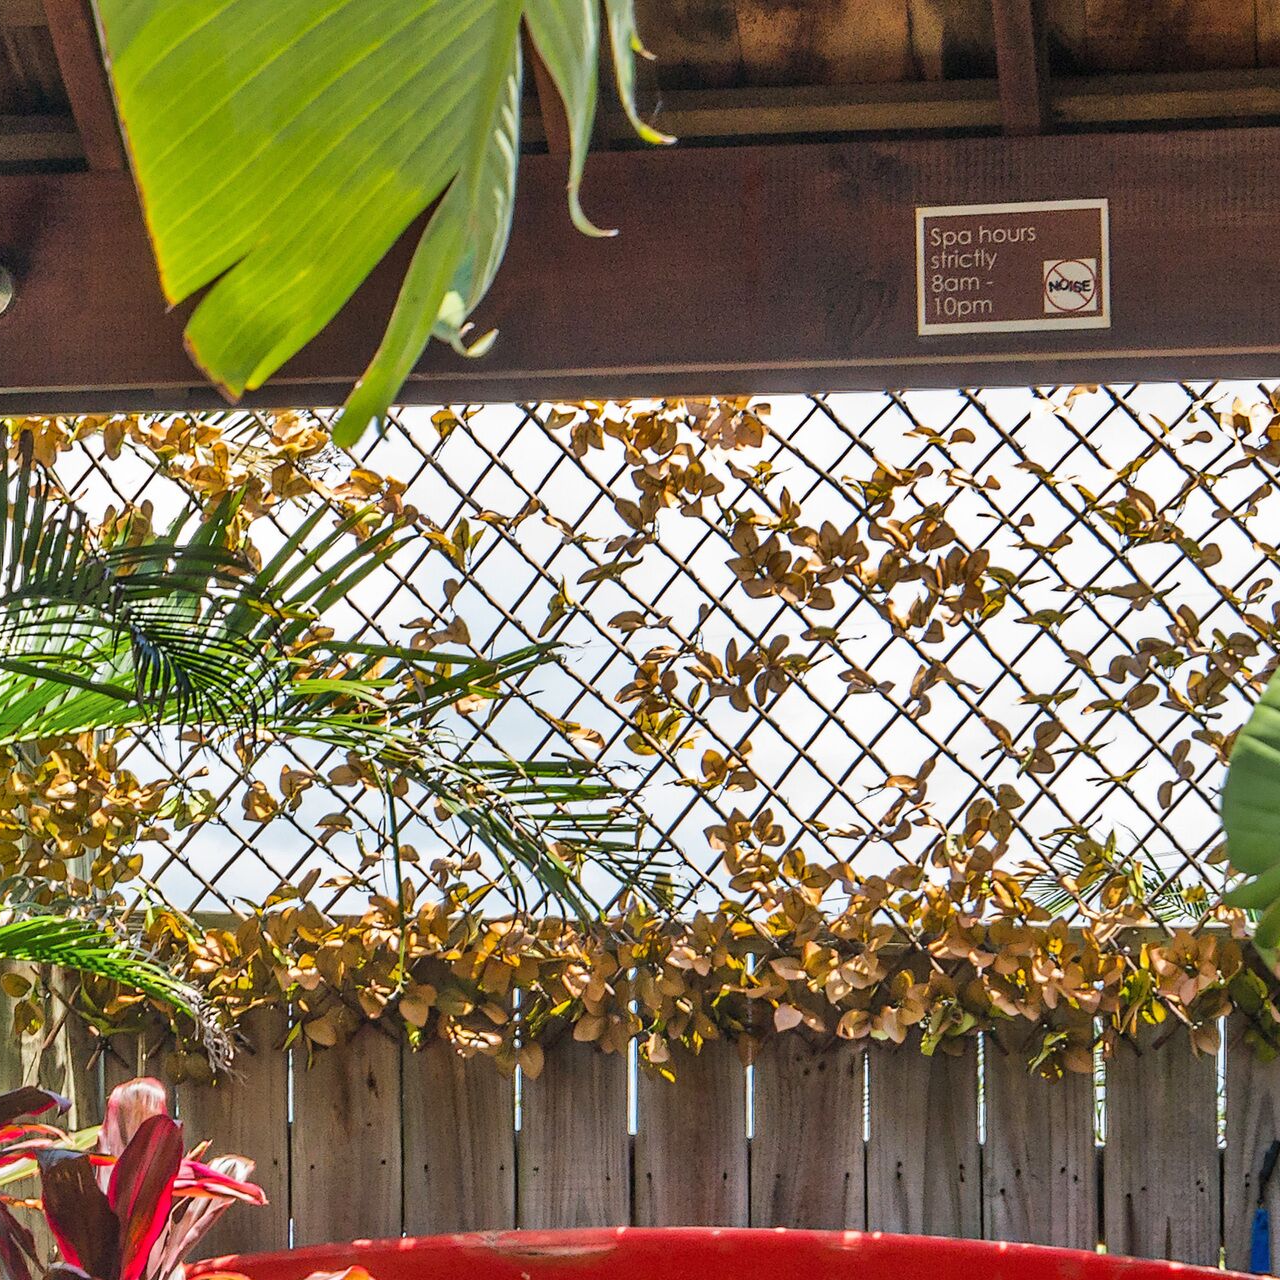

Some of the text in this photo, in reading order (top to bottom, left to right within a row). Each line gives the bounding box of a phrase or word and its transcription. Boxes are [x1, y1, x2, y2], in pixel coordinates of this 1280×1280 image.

[930, 225, 1036, 248] Spa hours
[930, 248, 998, 271] strictly
[931, 274, 980, 293] 8am
[1049, 277, 1091, 293] NOISE
[934, 297, 993, 318] 10pm
